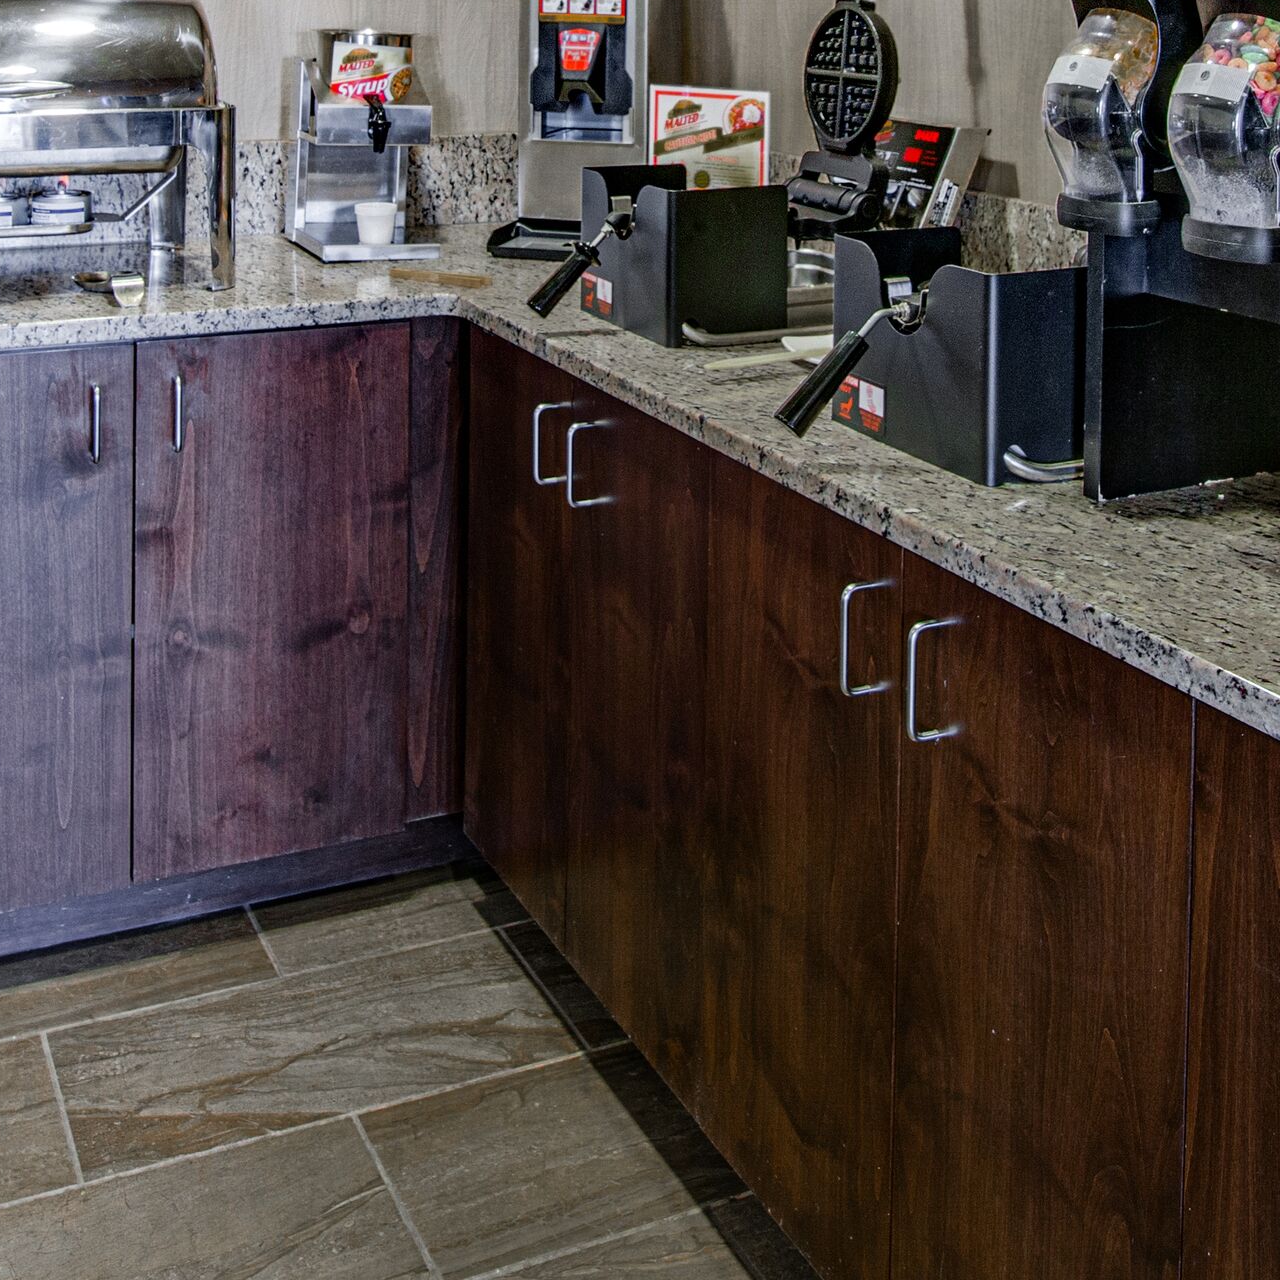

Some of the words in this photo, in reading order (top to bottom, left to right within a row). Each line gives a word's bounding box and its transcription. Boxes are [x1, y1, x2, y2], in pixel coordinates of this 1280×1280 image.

[338, 59, 376, 73] MALTED
[338, 78, 388, 98] Syrup
[664, 112, 700, 130] MALTED
